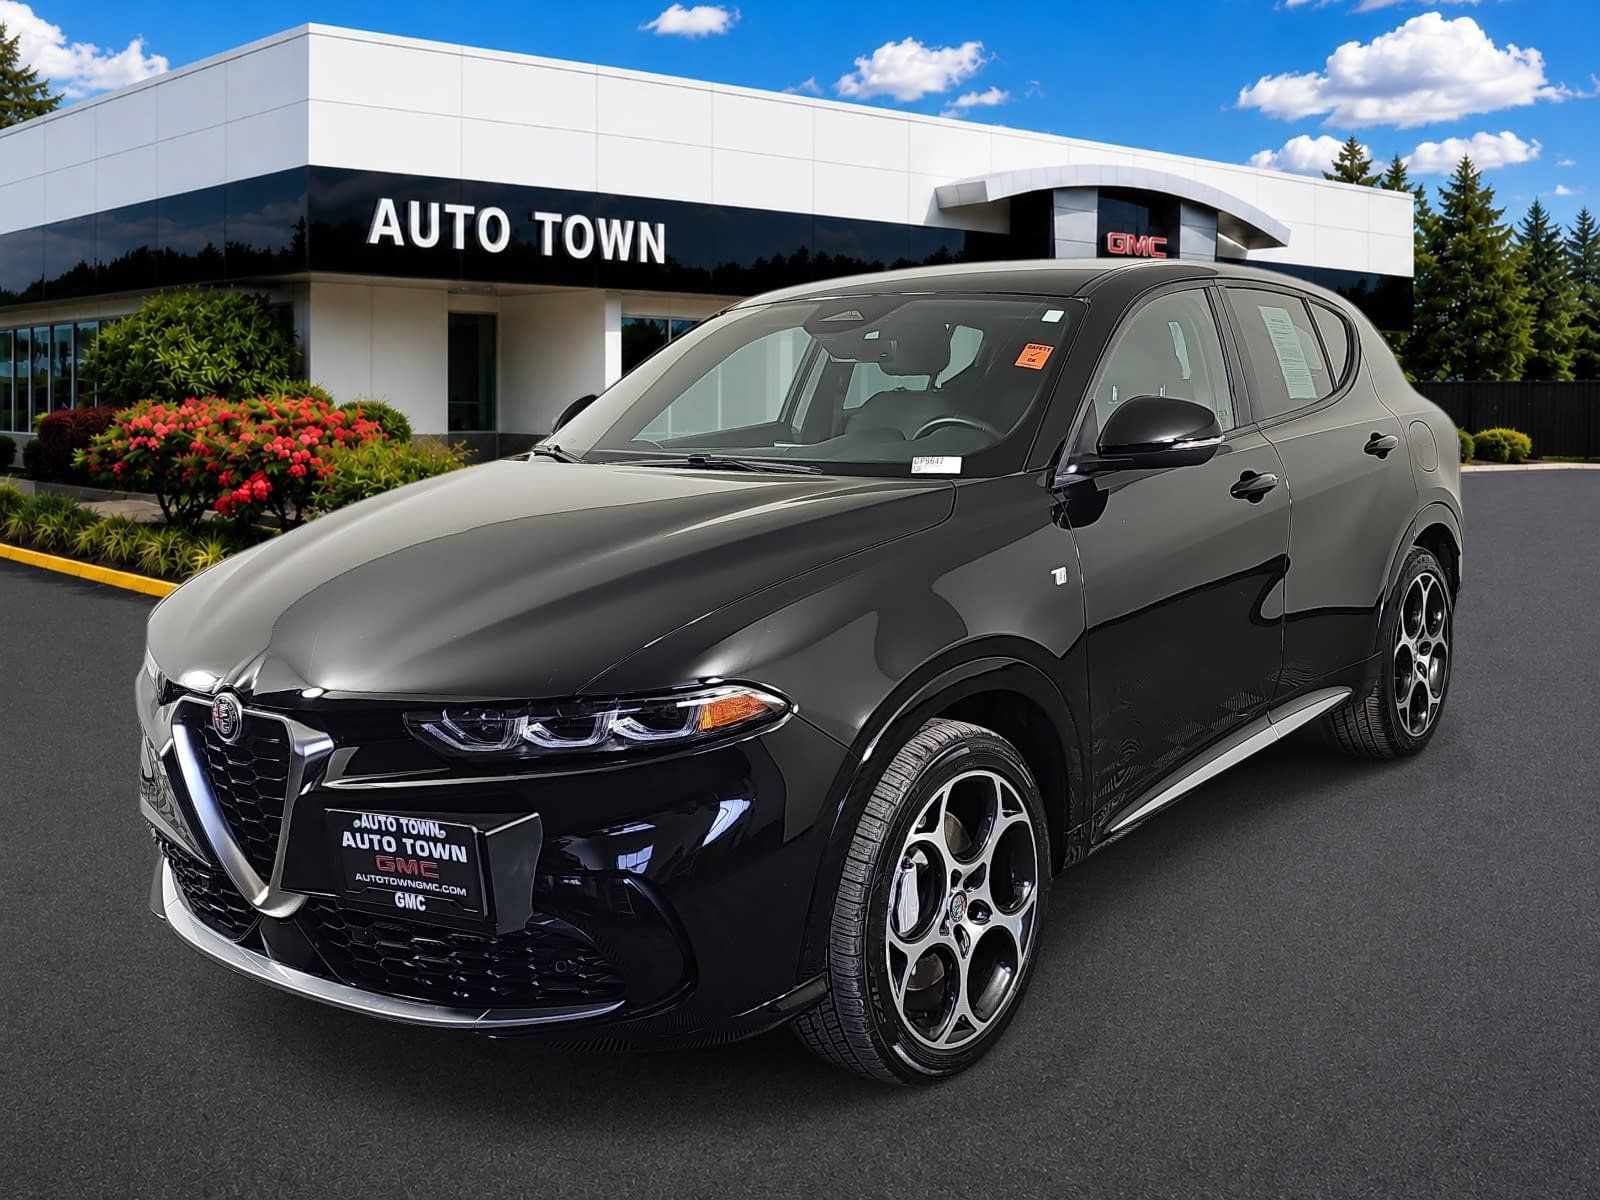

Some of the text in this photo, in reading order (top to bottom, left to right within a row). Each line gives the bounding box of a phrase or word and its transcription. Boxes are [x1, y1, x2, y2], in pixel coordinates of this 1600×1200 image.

[367, 197, 666, 265] AUTO TOWN
[1107, 231, 1168, 259] GMC
[360, 814, 441, 838] AUTO TOWN
[342, 831, 468, 863] AUTO TOWN
[375, 854, 440, 879] GMC
[355, 872, 467, 897] AUTOTOWNGMC.COM
[394, 891, 427, 911] GMC
